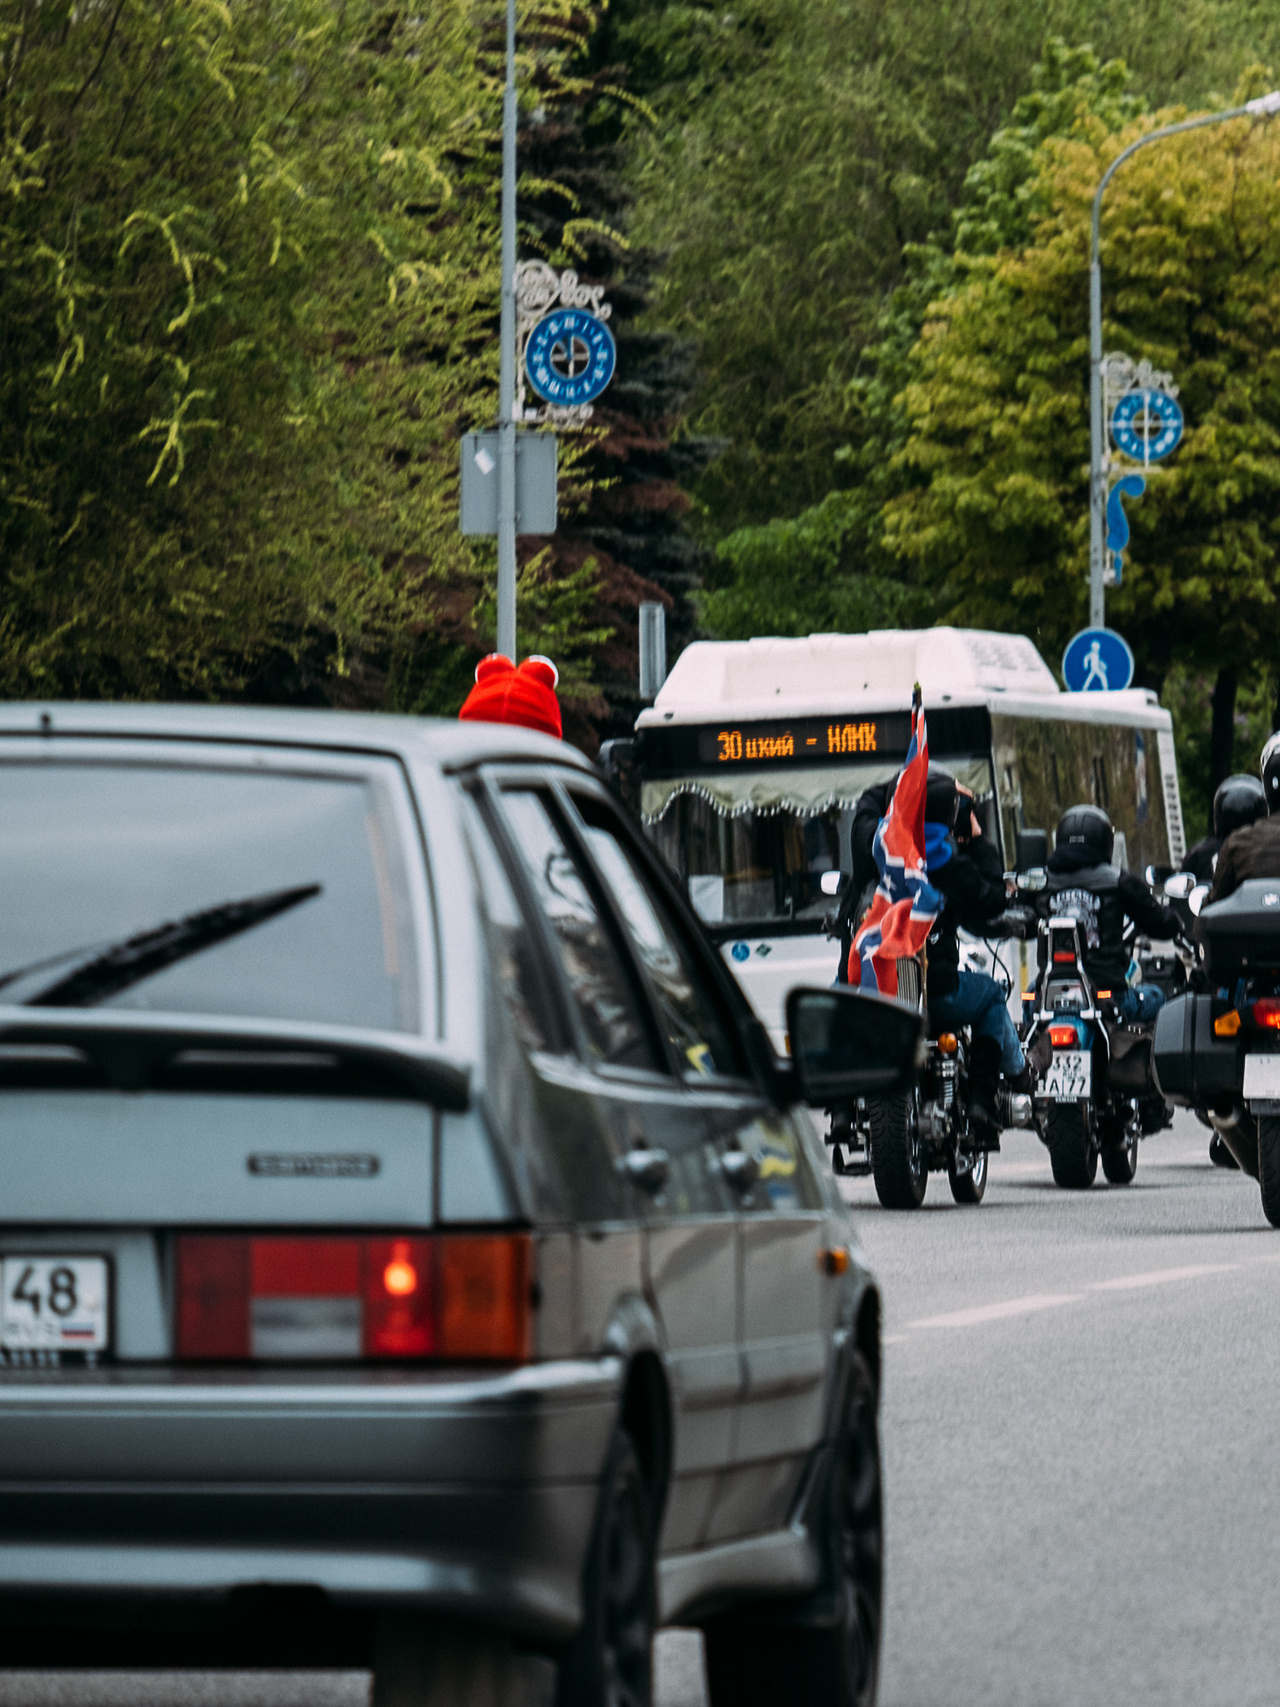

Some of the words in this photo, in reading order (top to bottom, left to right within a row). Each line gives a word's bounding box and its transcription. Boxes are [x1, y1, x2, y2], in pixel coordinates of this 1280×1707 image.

[718, 731, 742, 761] 30
[828, 722, 877, 752] НЛМК
[1068, 1076, 1087, 1094] 77
[12, 1264, 78, 1318] 48
